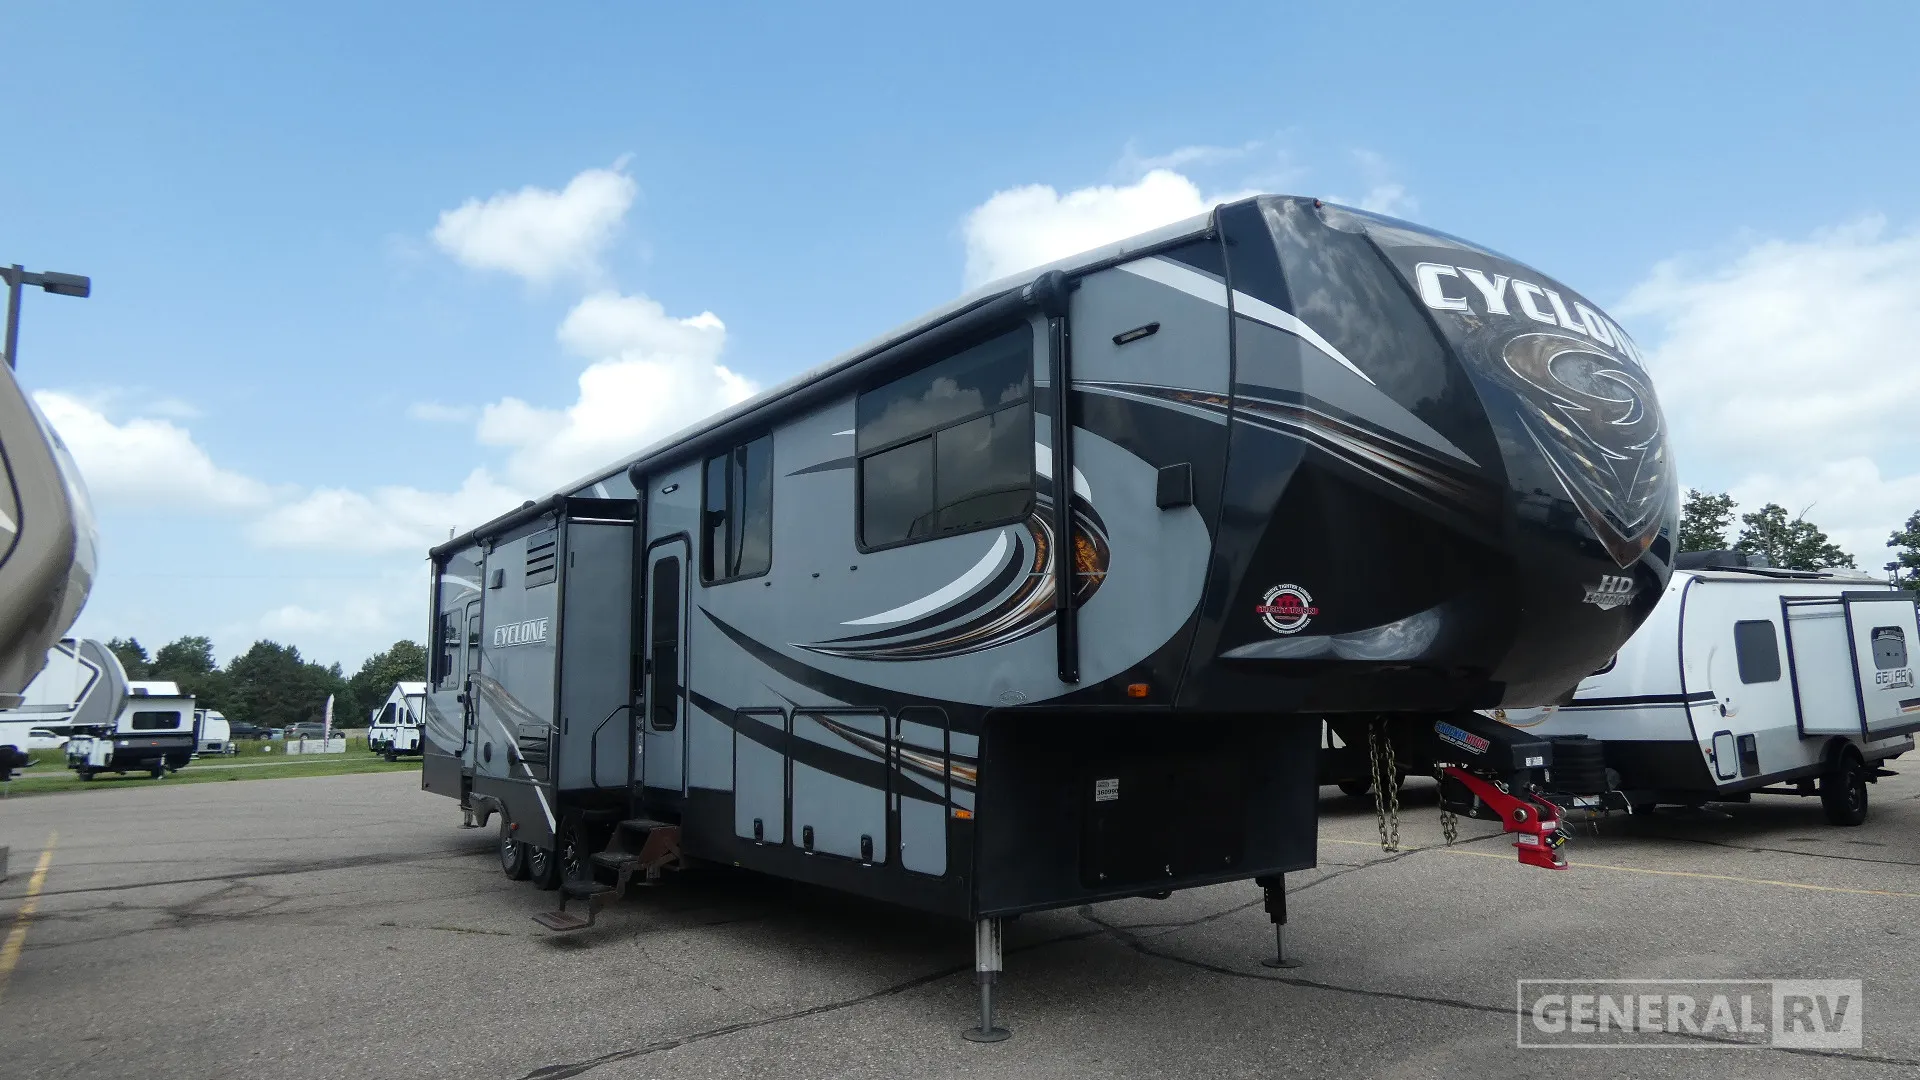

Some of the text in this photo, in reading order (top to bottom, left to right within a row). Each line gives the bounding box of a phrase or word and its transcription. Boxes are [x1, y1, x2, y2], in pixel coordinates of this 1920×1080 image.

[1597, 574, 1633, 593] HD
[1259, 605, 1316, 615] TIGHT TURN
[493, 616, 548, 649] CYCLONE
